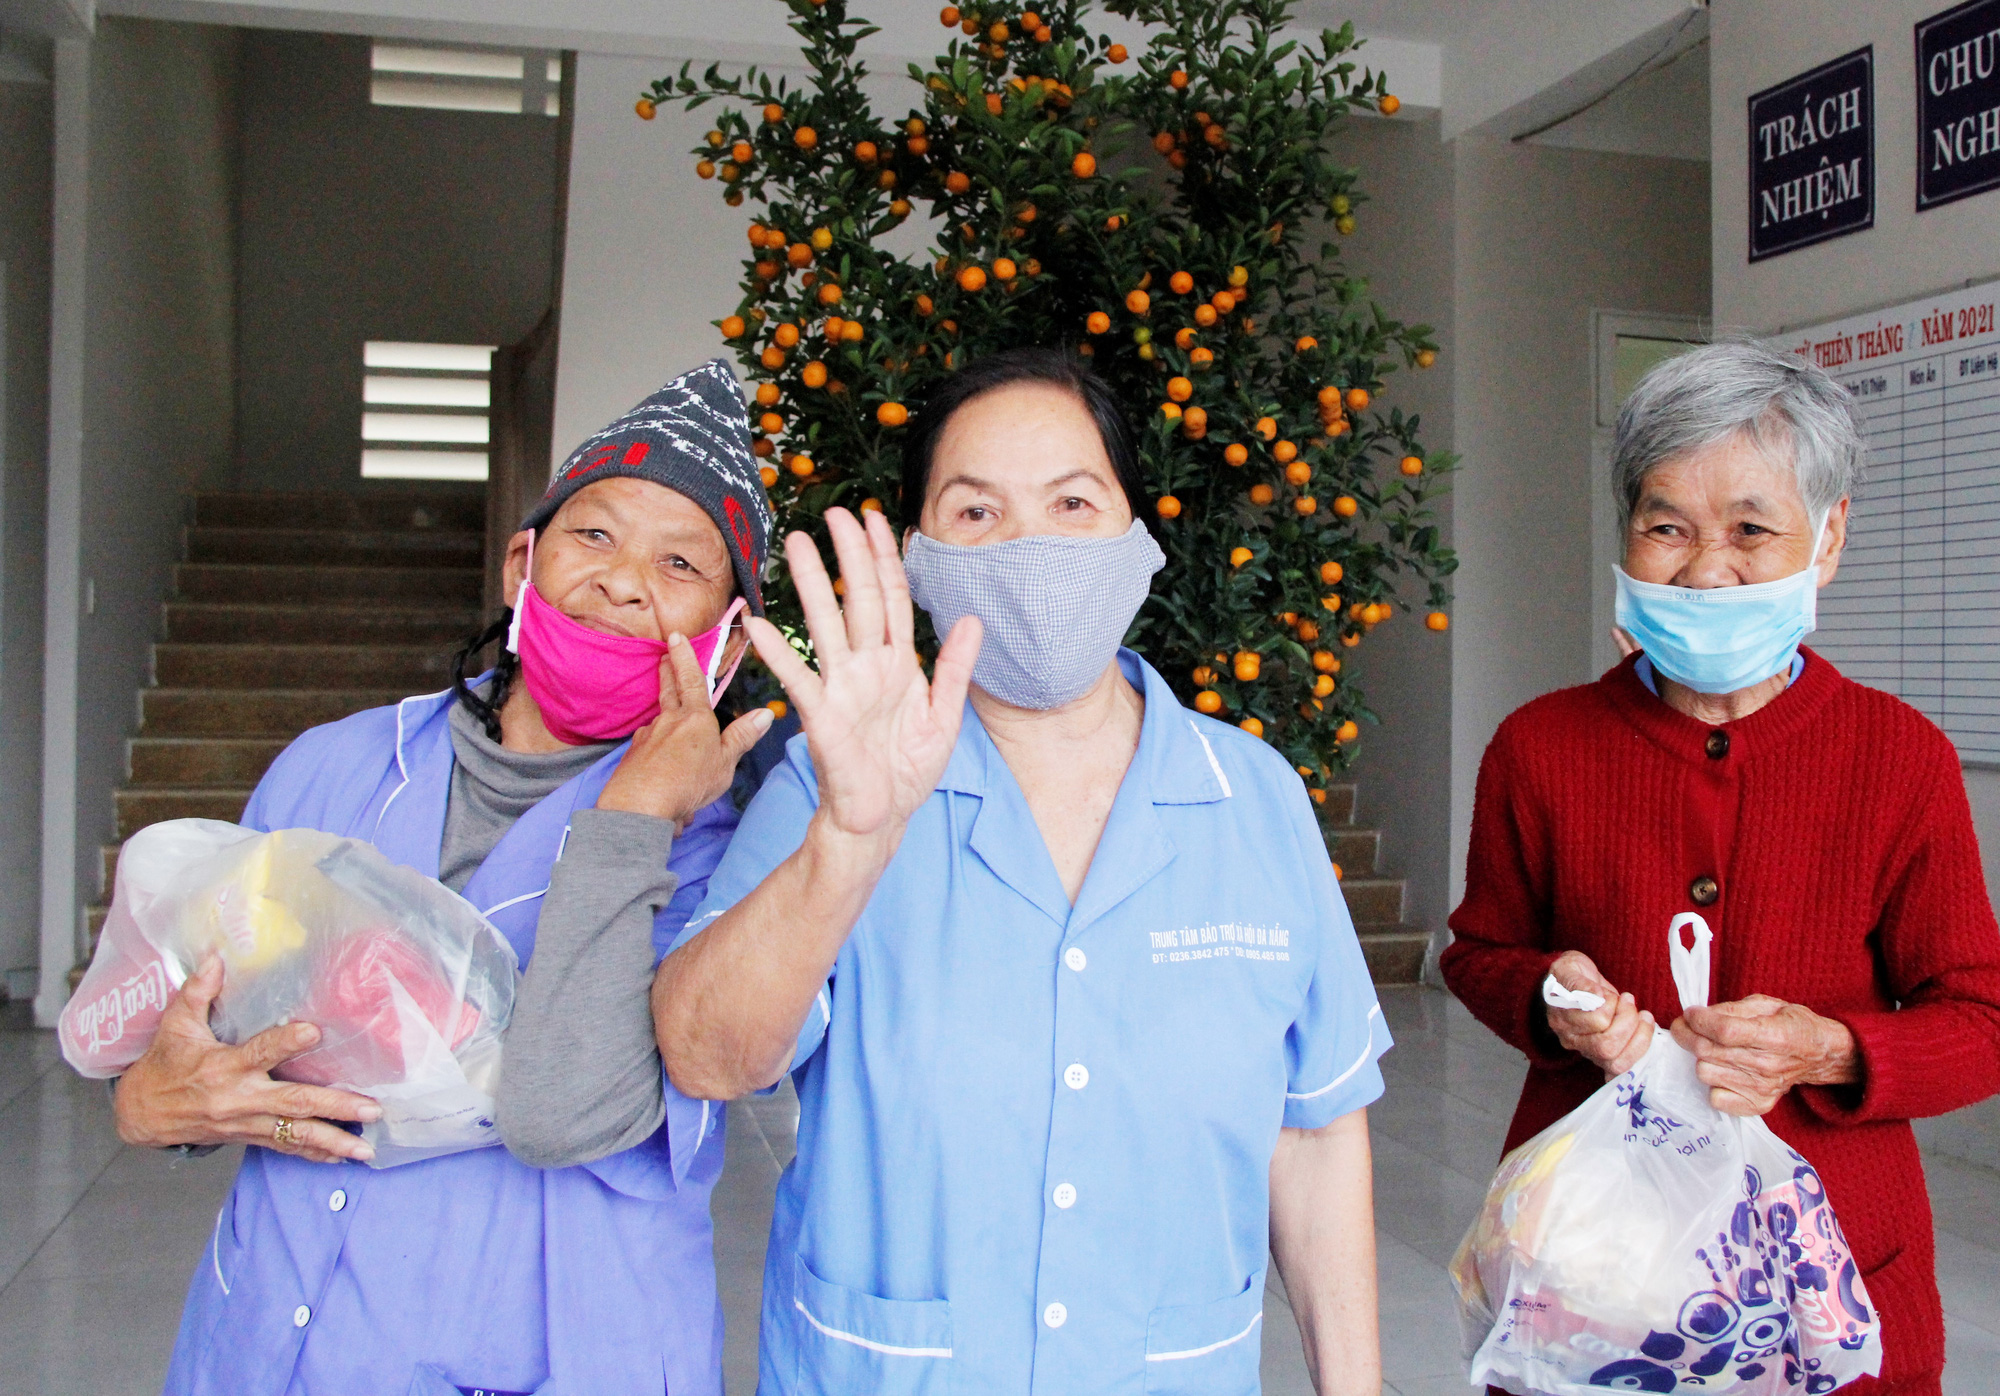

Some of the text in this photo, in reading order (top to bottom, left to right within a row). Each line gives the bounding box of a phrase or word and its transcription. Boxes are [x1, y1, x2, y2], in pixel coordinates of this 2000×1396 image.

[1928, 31, 2000, 97] CHU
[1759, 93, 1862, 163] TRÁCH
[1931, 106, 2000, 171] NGH
[1760, 155, 1862, 229] NHIỆM
[1857, 321, 1904, 360] THÁNG
[1921, 308, 1954, 347] NĂM
[1959, 303, 1995, 339] 2021
[1149, 930, 1178, 948] TRUNG
[1179, 925, 1199, 946] TÂM
[1200, 921, 1218, 944] BẢO
[1219, 921, 1236, 944] TRỢ
[1257, 923, 1267, 945] ĐÀ
[1152, 953, 1168, 963] ĐT:
[1169, 948, 1212, 962] 0236.3842
[1214, 946, 1230, 957] 475
